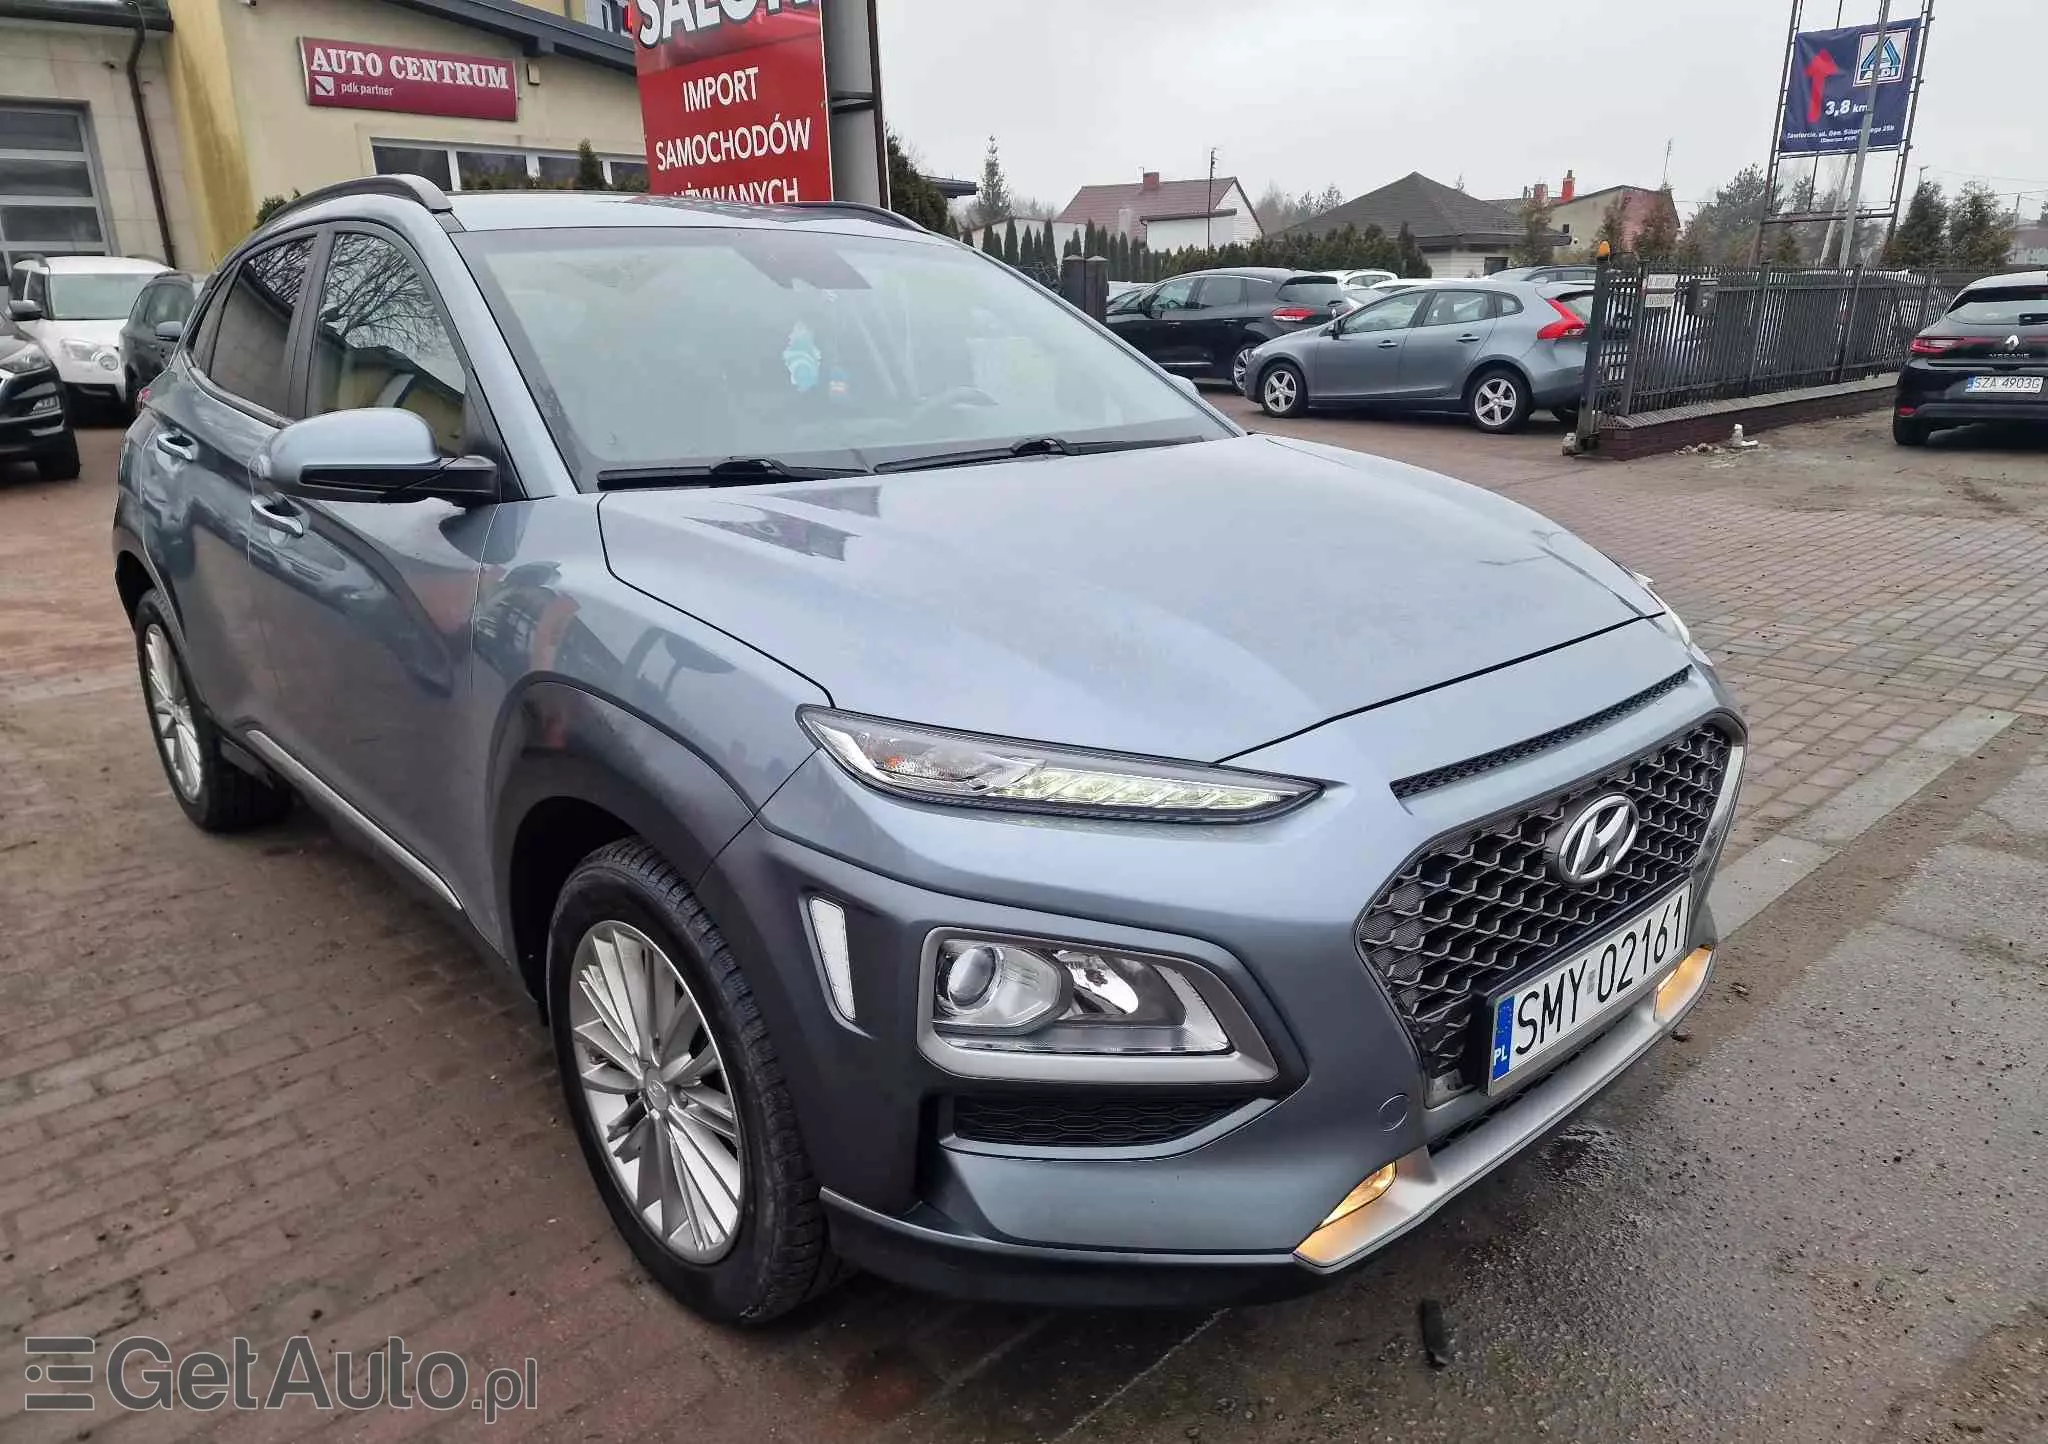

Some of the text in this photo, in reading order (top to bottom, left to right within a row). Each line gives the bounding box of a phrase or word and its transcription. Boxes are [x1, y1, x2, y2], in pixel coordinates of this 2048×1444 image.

[639, 0, 809, 46] SAL
[311, 47, 509, 89] AUTO CENTRUM
[1863, 67, 1896, 80] ADI
[360, 85, 394, 97] partner
[683, 66, 759, 112] IMPORT
[1825, 99, 1851, 117] 3,8
[656, 113, 812, 172] SAMOCHODÓW
[674, 177, 799, 204] ANYCH
[1975, 376, 1997, 389] SZA
[1515, 895, 1684, 1056] SMY 02161
[1493, 1047, 1508, 1066] PL
